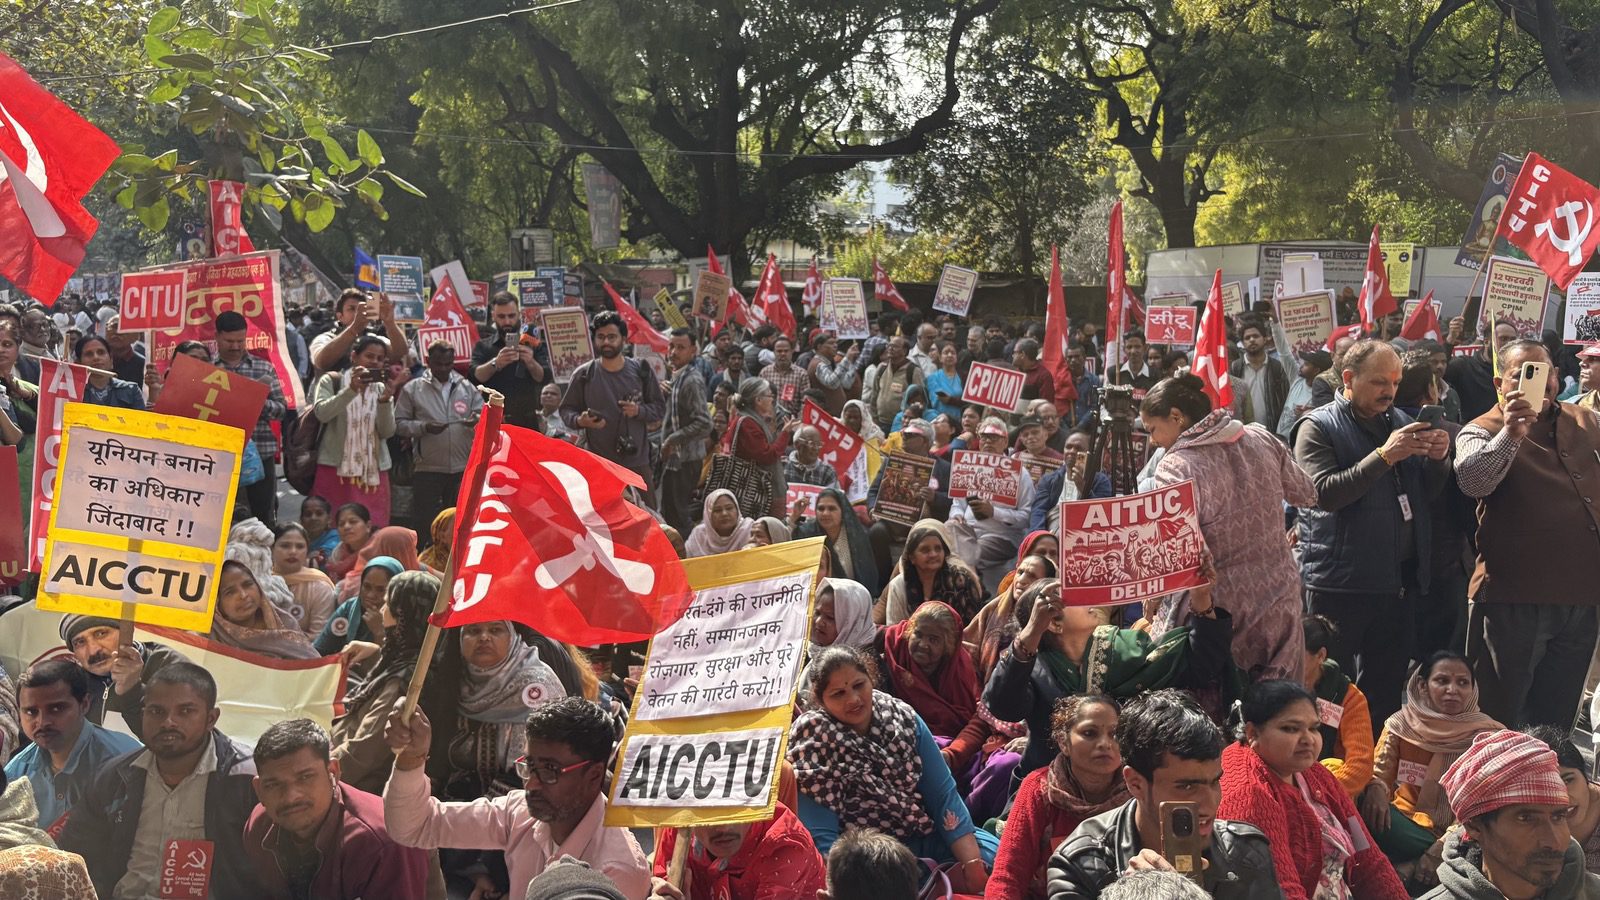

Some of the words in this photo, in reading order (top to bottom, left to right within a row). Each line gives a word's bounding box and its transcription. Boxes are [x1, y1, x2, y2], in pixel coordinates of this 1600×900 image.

[1508, 164, 1551, 233] CITU
[1494, 273, 1504, 281] 12
[1504, 274, 1535, 286] फरवरी
[123, 284, 182, 319] CITU
[1501, 302, 1523, 312] CPIM
[1149, 309, 1192, 331] सीटू
[1297, 331, 1317, 339] CPIM
[967, 364, 1024, 411] CPI(M)
[87, 438, 159, 466] यूनियन
[164, 453, 216, 475] बनाने
[959, 453, 1013, 470] AITUC
[88, 475, 119, 493] का
[124, 477, 205, 507] अधिकार
[86, 502, 169, 536] जिंदाबाद
[175, 518, 194, 538] !!
[1082, 488, 1183, 529] AITUC
[51, 553, 208, 602] AICCTU
[1111, 579, 1165, 602] DELHI
[729, 593, 747, 613] की
[750, 583, 805, 610] राजनीति
[673, 628, 699, 650] नहीं,
[706, 619, 784, 645] सम्मानजनक
[706, 655, 743, 679] सुरक्षा
[746, 647, 773, 668] और
[777, 643, 795, 669] पूरे
[648, 688, 678, 708] वेतन
[681, 685, 699, 705] की
[702, 680, 739, 703] गारंटी
[620, 736, 776, 801] AICCTU
[162, 841, 178, 895] AICCTU
